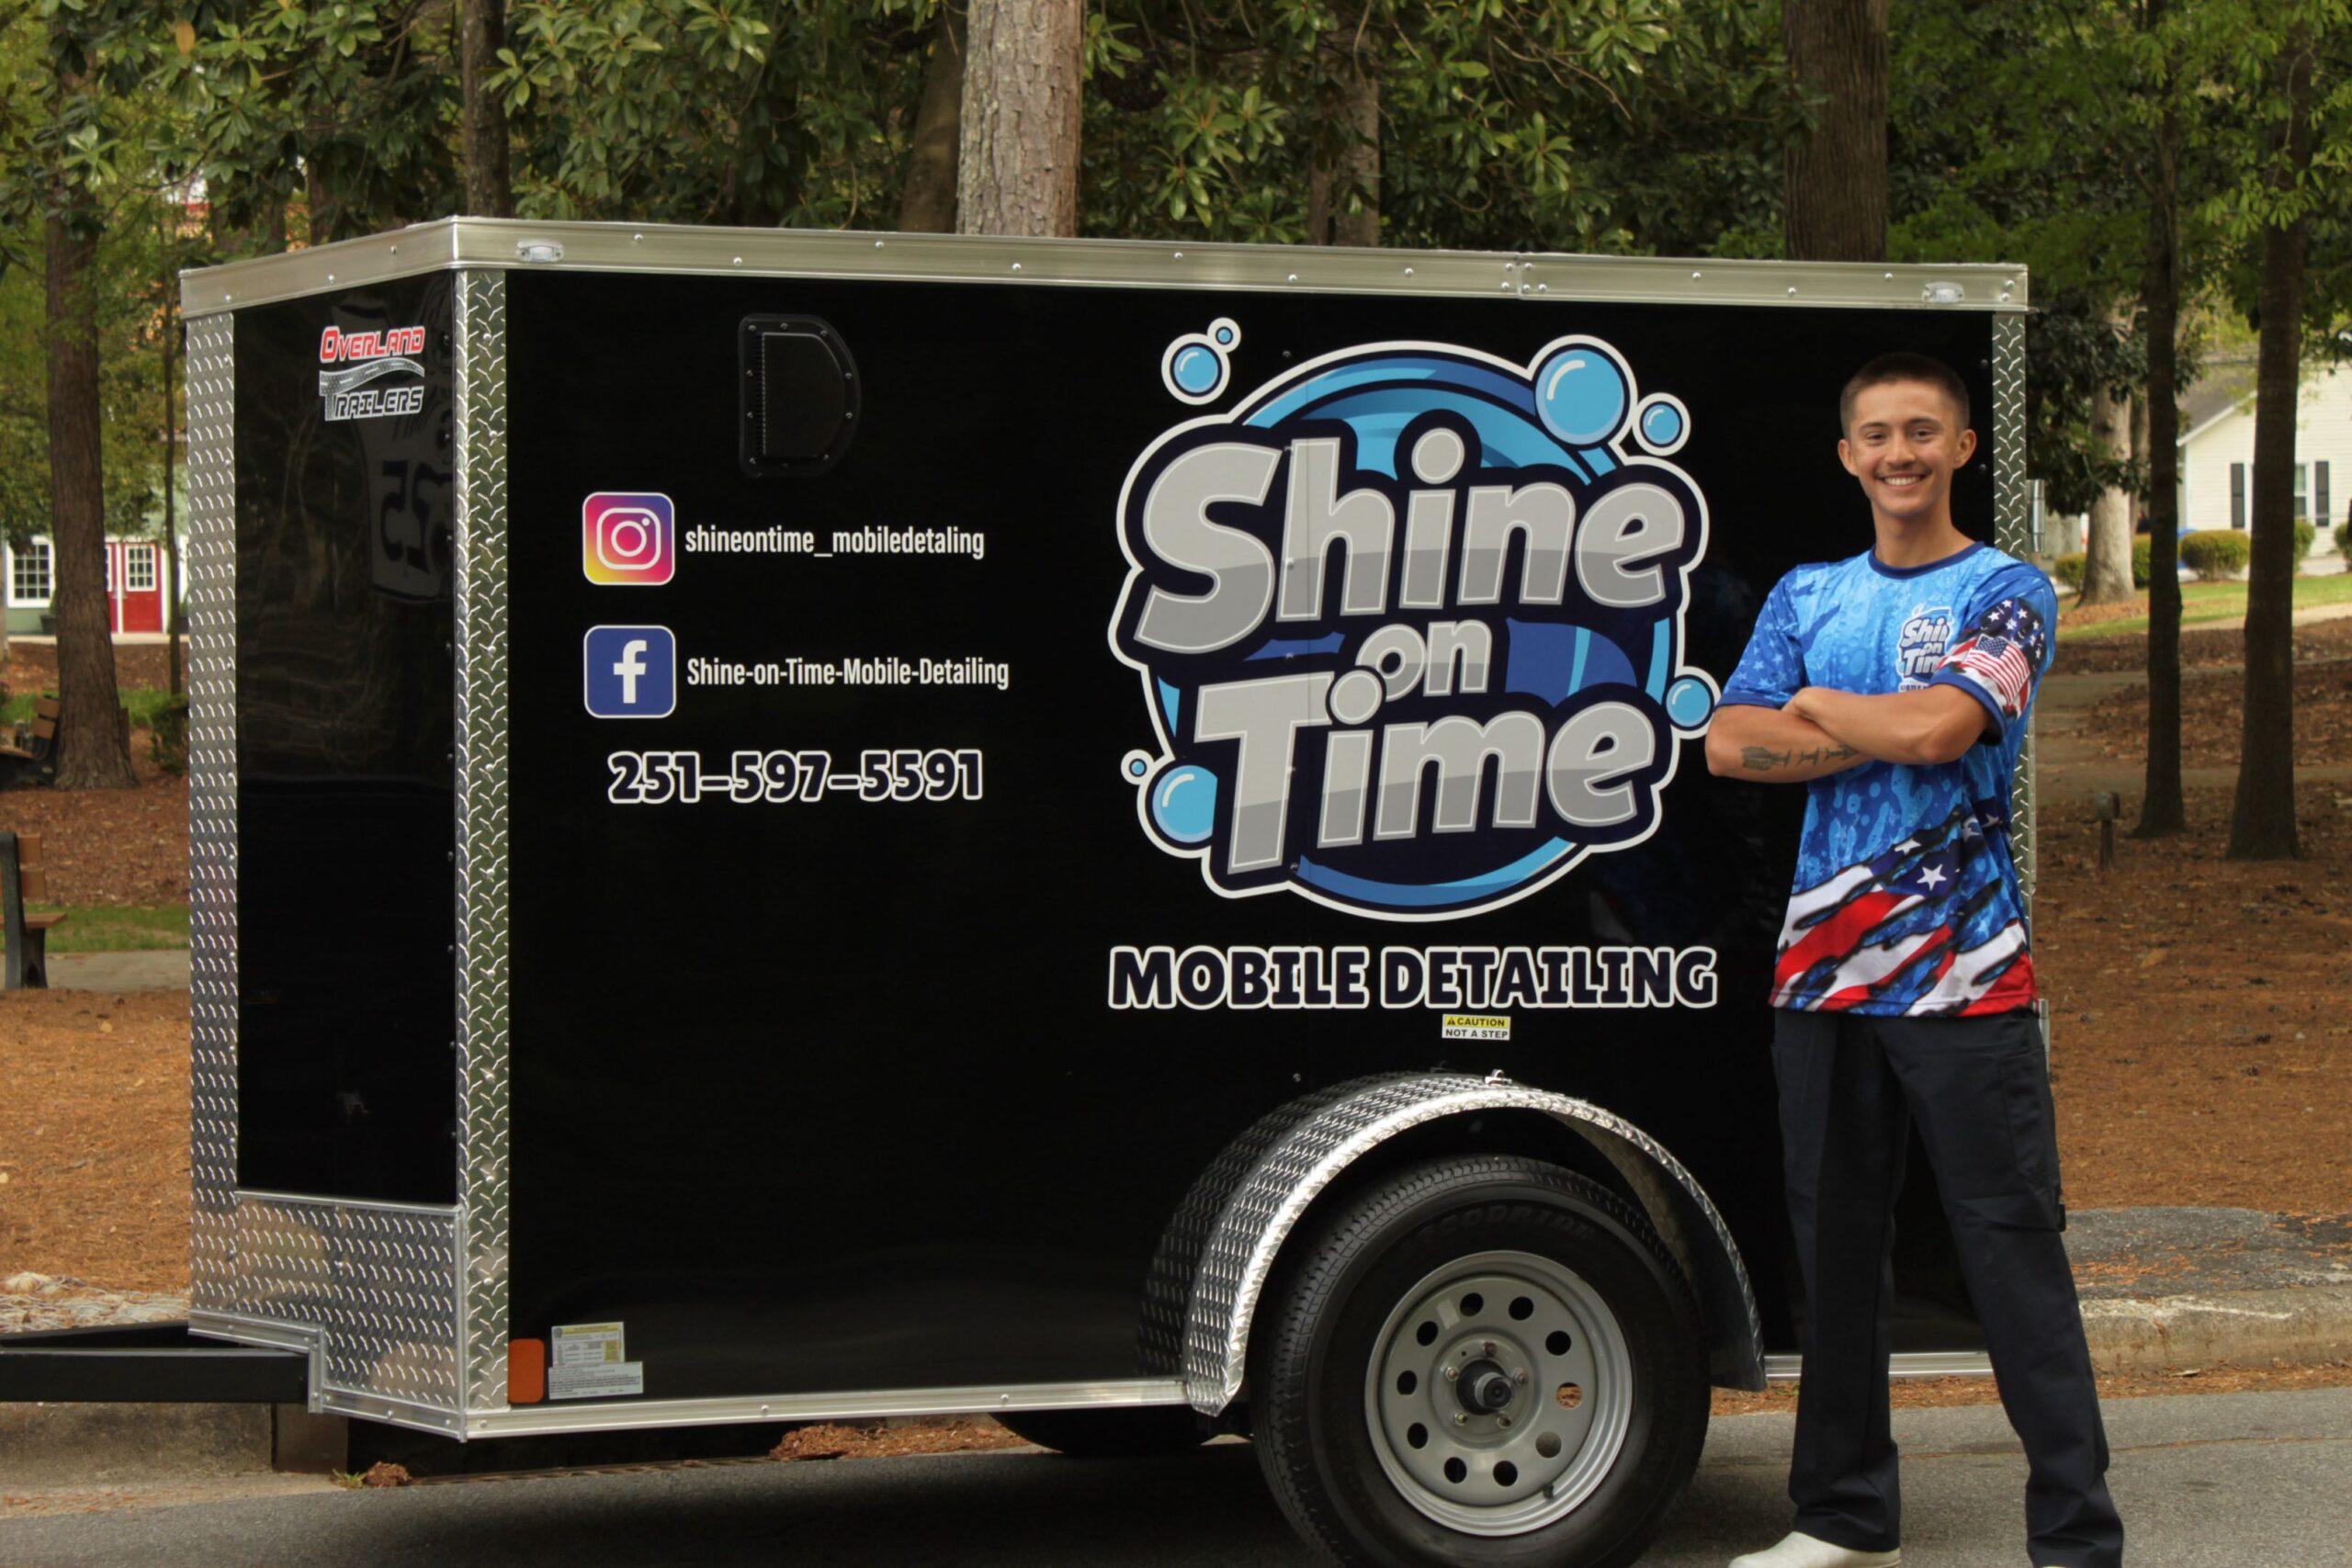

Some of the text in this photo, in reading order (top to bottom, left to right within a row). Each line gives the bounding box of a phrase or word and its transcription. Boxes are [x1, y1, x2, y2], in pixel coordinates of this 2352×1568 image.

[320, 326, 425, 363] OVERLAND
[320, 383, 424, 422] TRAILERS
[684, 525, 985, 560] shineontime_mobiledetaling
[1134, 427, 1685, 654] Shine
[1355, 619, 1493, 702] on
[1924, 641, 1943, 654] on
[687, 657, 1010, 690] Shine-on-Time-Mobile-Detailing
[607, 749, 983, 805] 251-597-5591
[1193, 669, 1656, 874] Time
[1108, 945, 1718, 1010] MOBILE DETAILING
[1445, 1029, 1509, 1039] NOT A STEP
[1456, 1017, 1505, 1027] CAUTION
